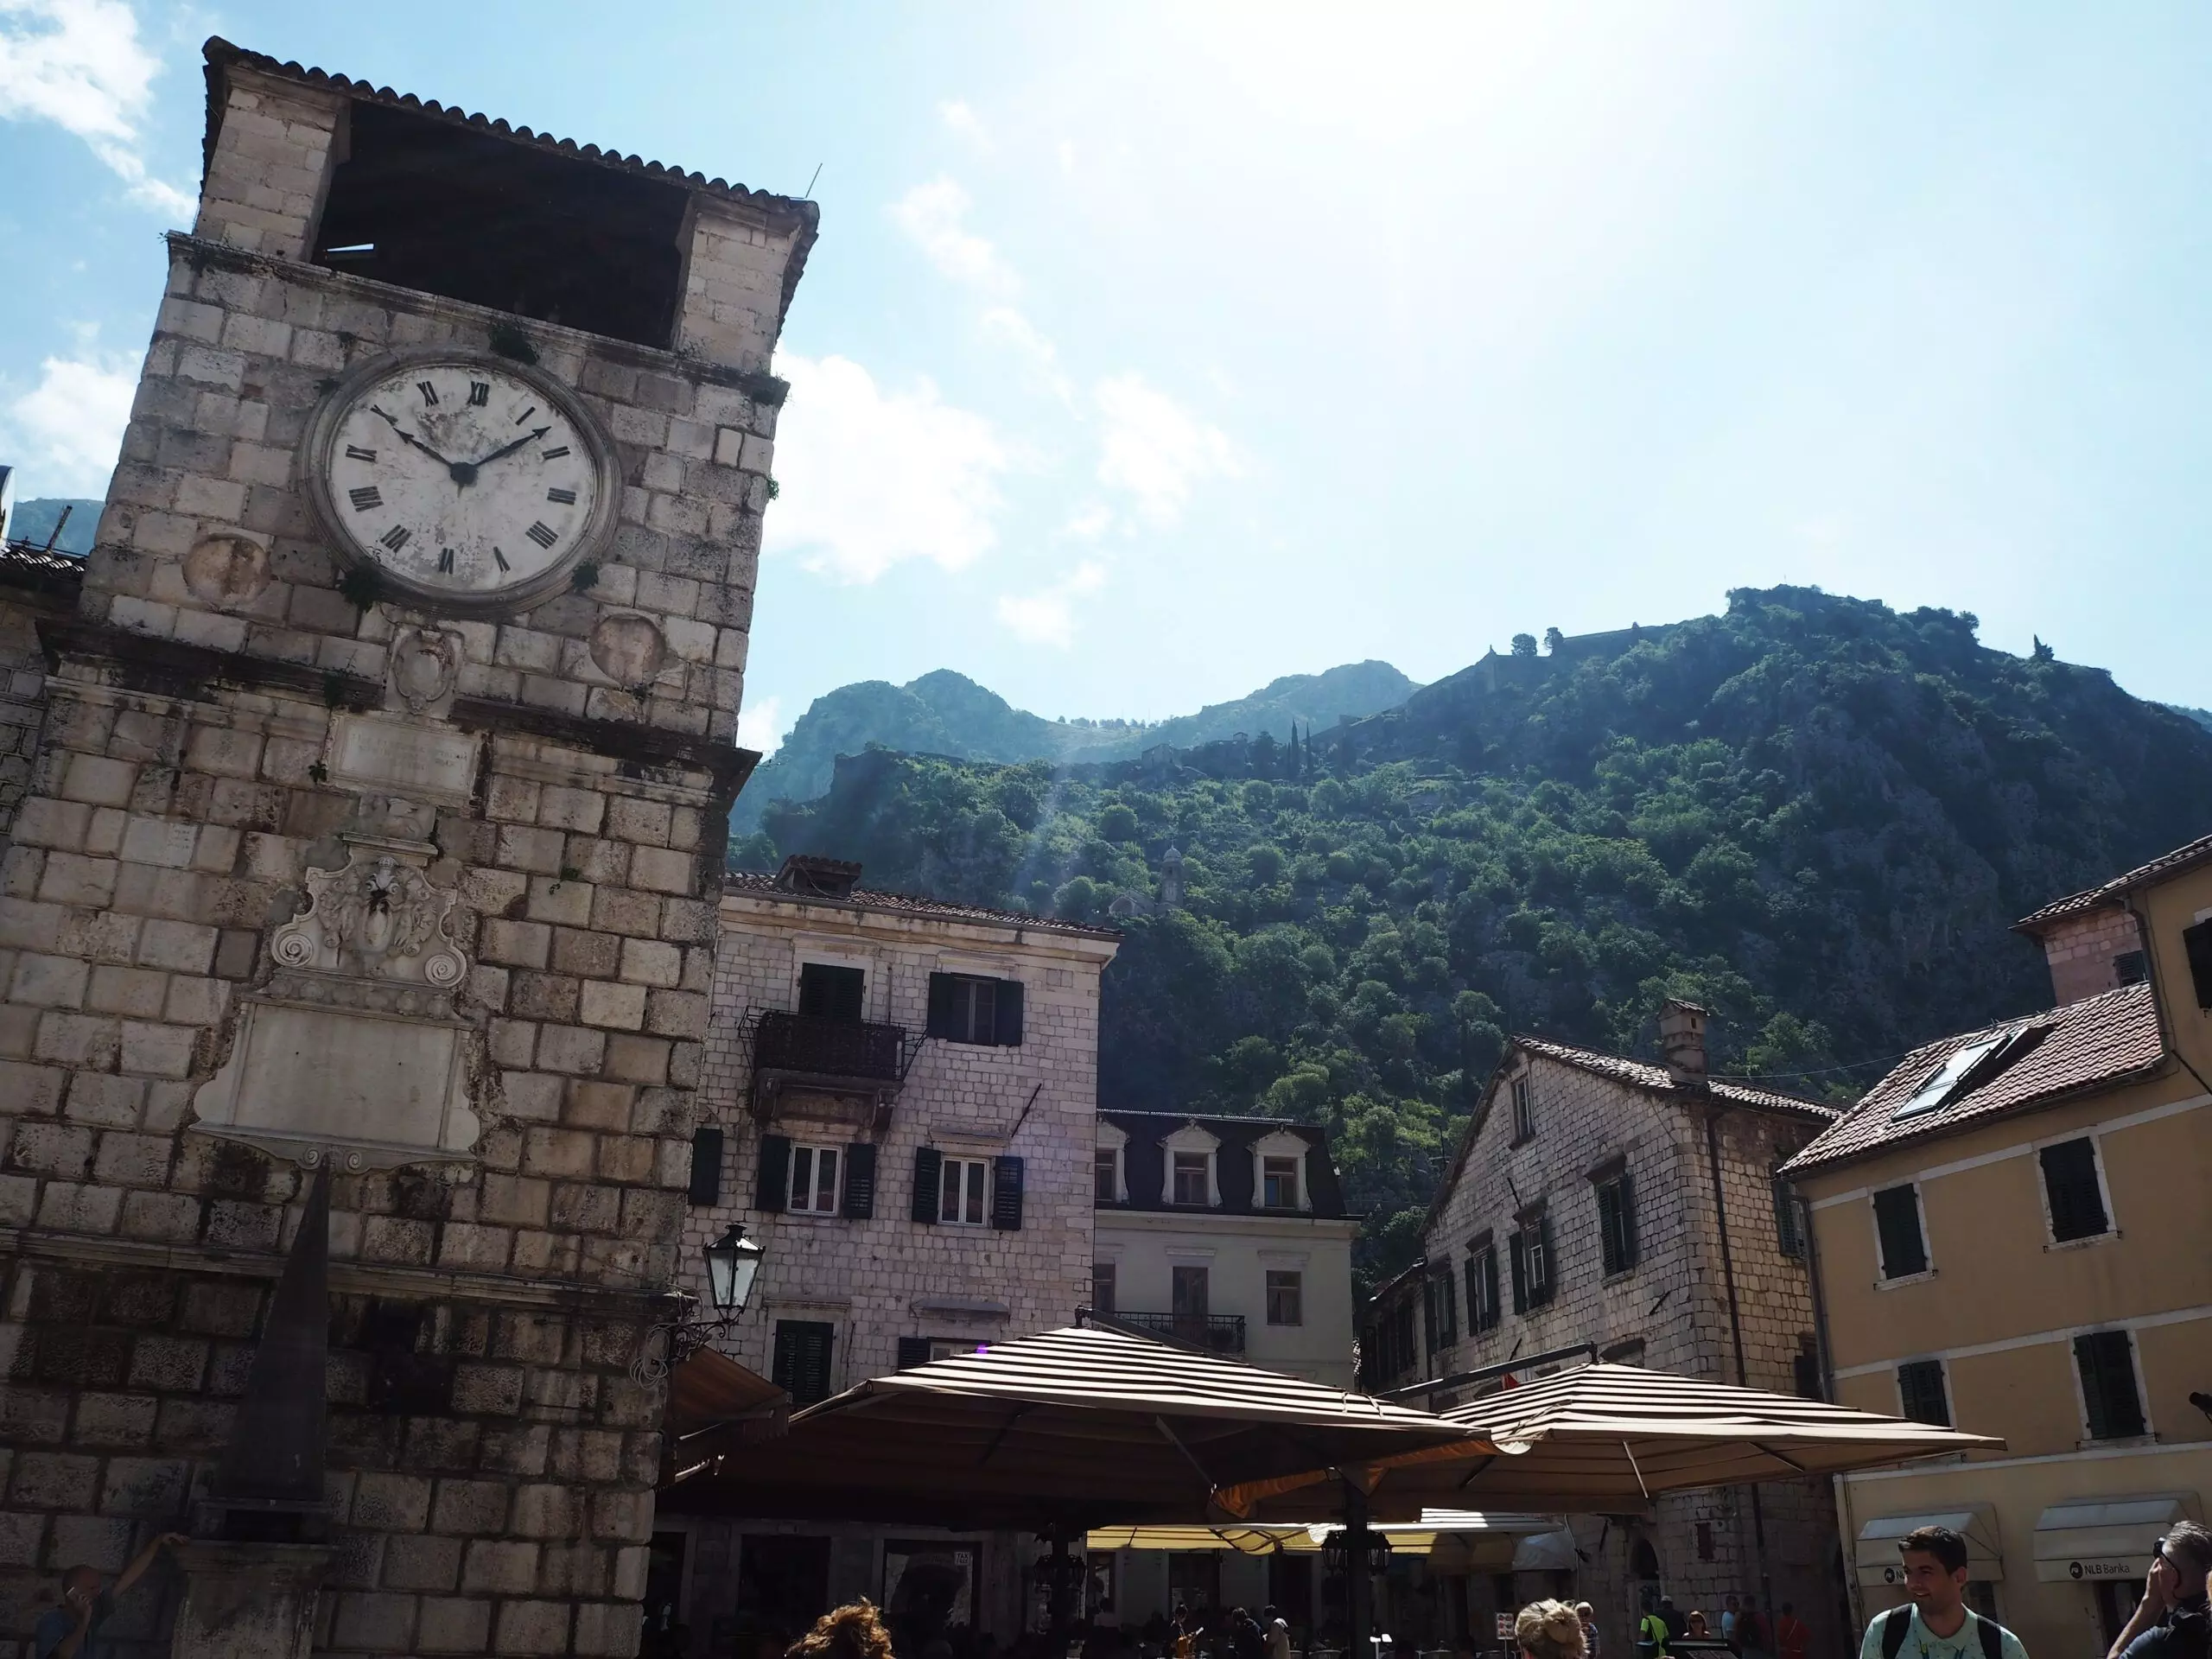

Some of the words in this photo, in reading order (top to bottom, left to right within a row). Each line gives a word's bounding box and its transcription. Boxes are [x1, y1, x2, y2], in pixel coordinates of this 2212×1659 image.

[416, 381, 439, 407] XI
[466, 381, 490, 407] XII
[370, 404, 398, 426] X
[515, 406, 536, 426] I
[346, 443, 378, 462] IX
[542, 445, 571, 461] II
[547, 486, 576, 505] III
[380, 524, 413, 553] VII
[524, 520, 559, 550] IIII
[493, 546, 511, 572] V
[2084, 1564, 2102, 1575] NLB
[2103, 1562, 2131, 1574] Banka
